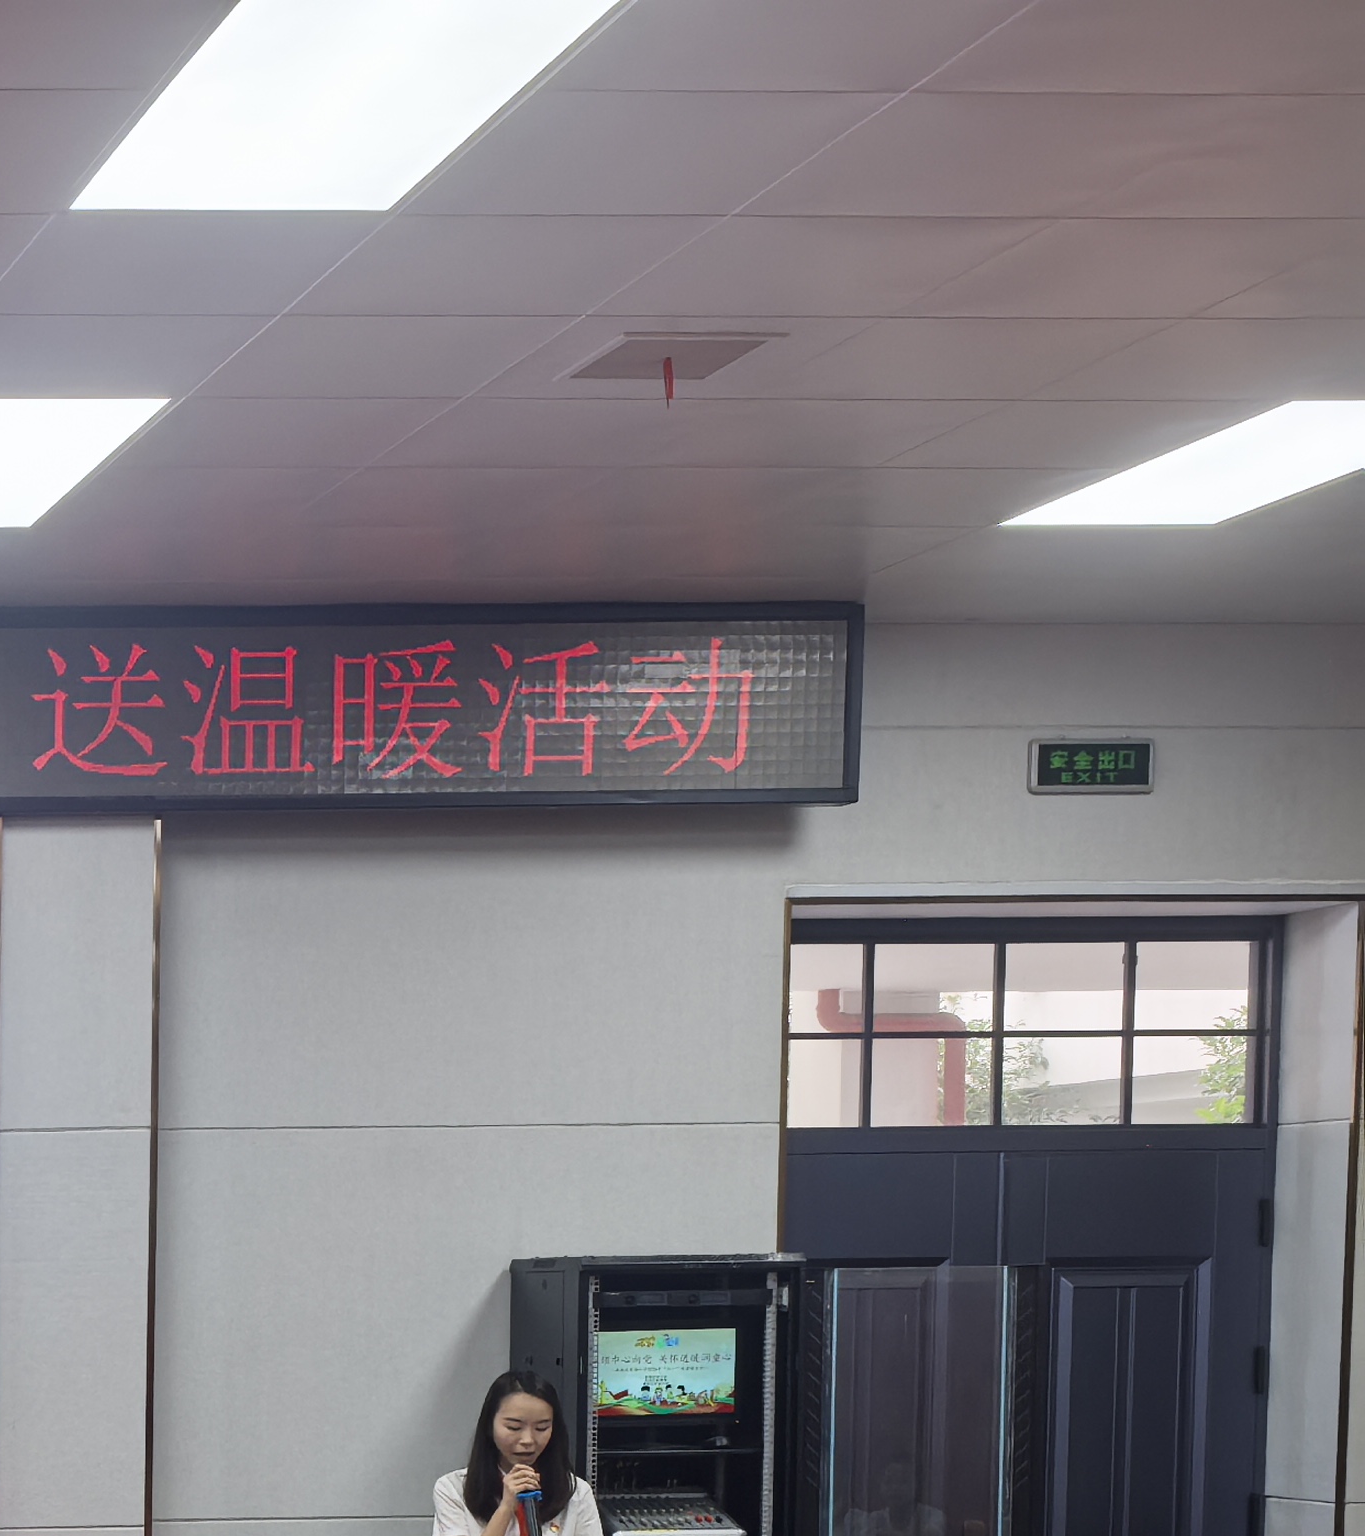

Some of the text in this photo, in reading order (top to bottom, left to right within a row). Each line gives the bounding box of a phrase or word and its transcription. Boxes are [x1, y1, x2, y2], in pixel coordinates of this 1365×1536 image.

[1049, 750, 1136, 770] 安全出口
[1060, 771, 1118, 783] EXIT
